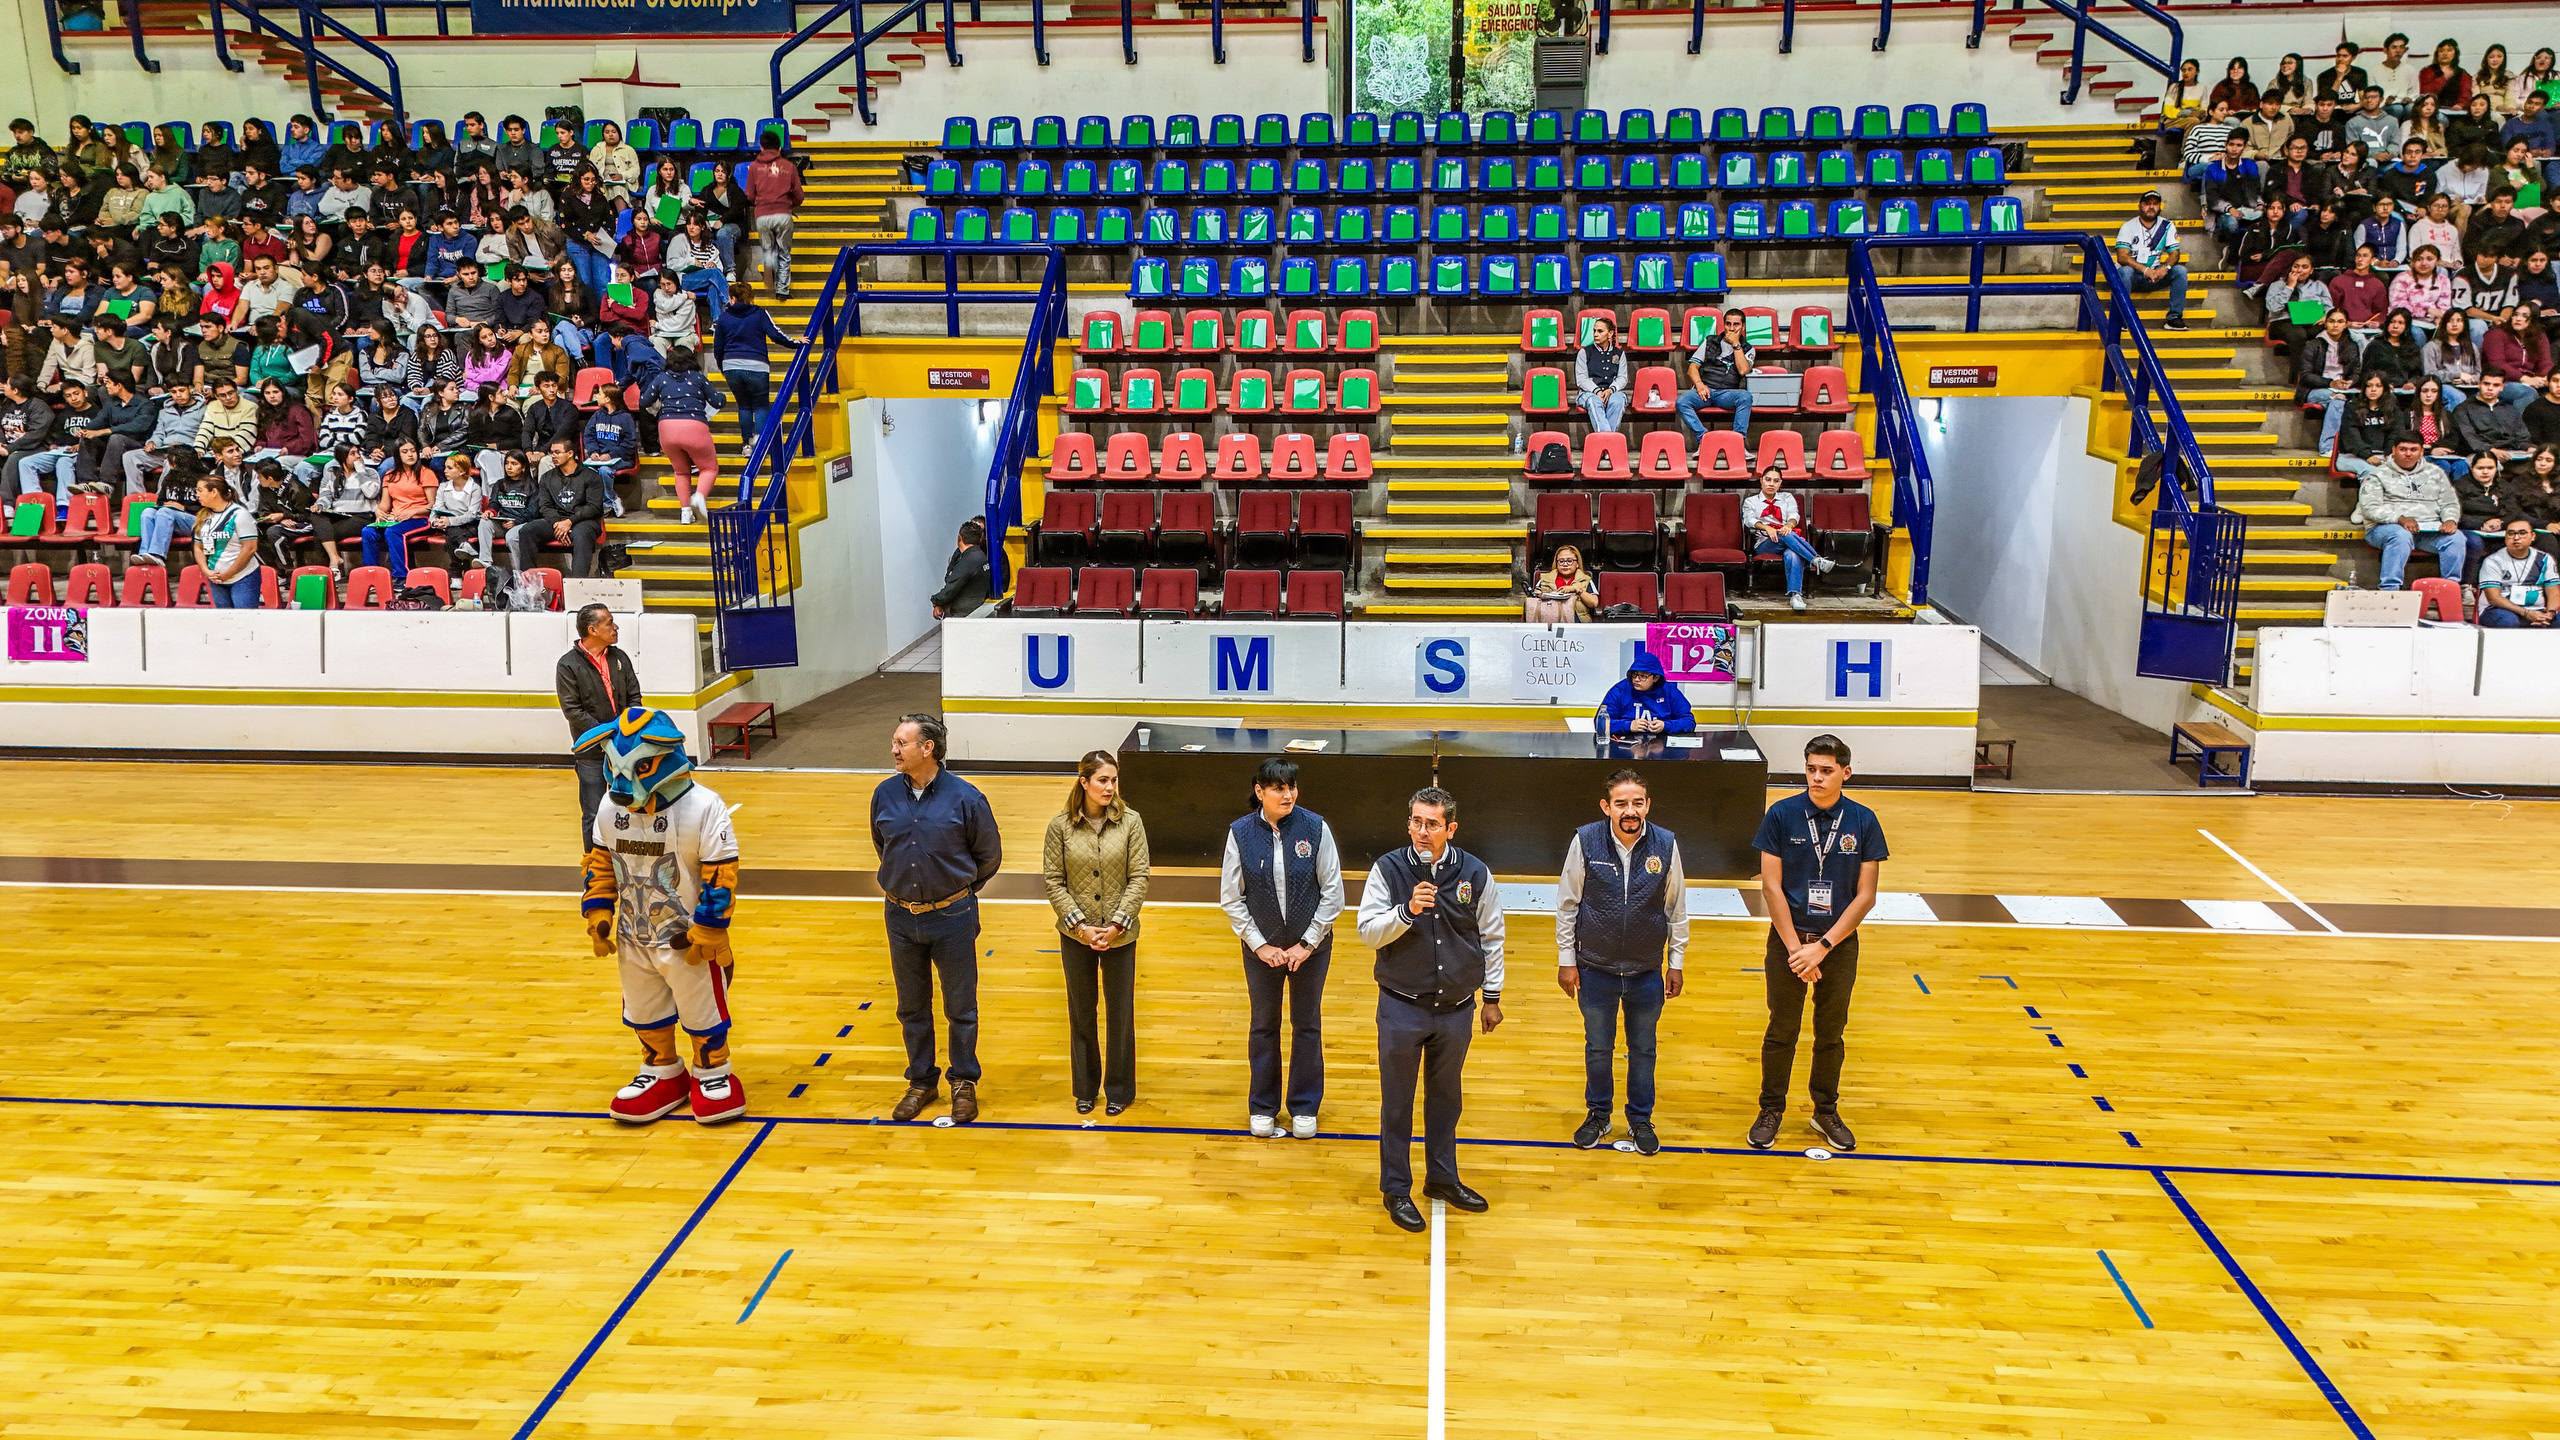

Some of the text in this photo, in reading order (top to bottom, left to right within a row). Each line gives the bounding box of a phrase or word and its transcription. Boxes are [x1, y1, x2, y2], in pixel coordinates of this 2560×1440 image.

[1488, 4, 1537, 17] SALIDA DE
[1481, 19, 1541, 32] EMERGENCI
[24, 607, 68, 621] ZONA
[31, 625, 65, 653] 11
[1666, 625, 1717, 639] ZONA
[1521, 634, 1585, 653] CIENCIAS
[1532, 655, 1571, 669] DE LA
[1669, 644, 1716, 673] 12
[1027, 635, 1882, 697] U M S H
[1526, 671, 1577, 686] SALUD
